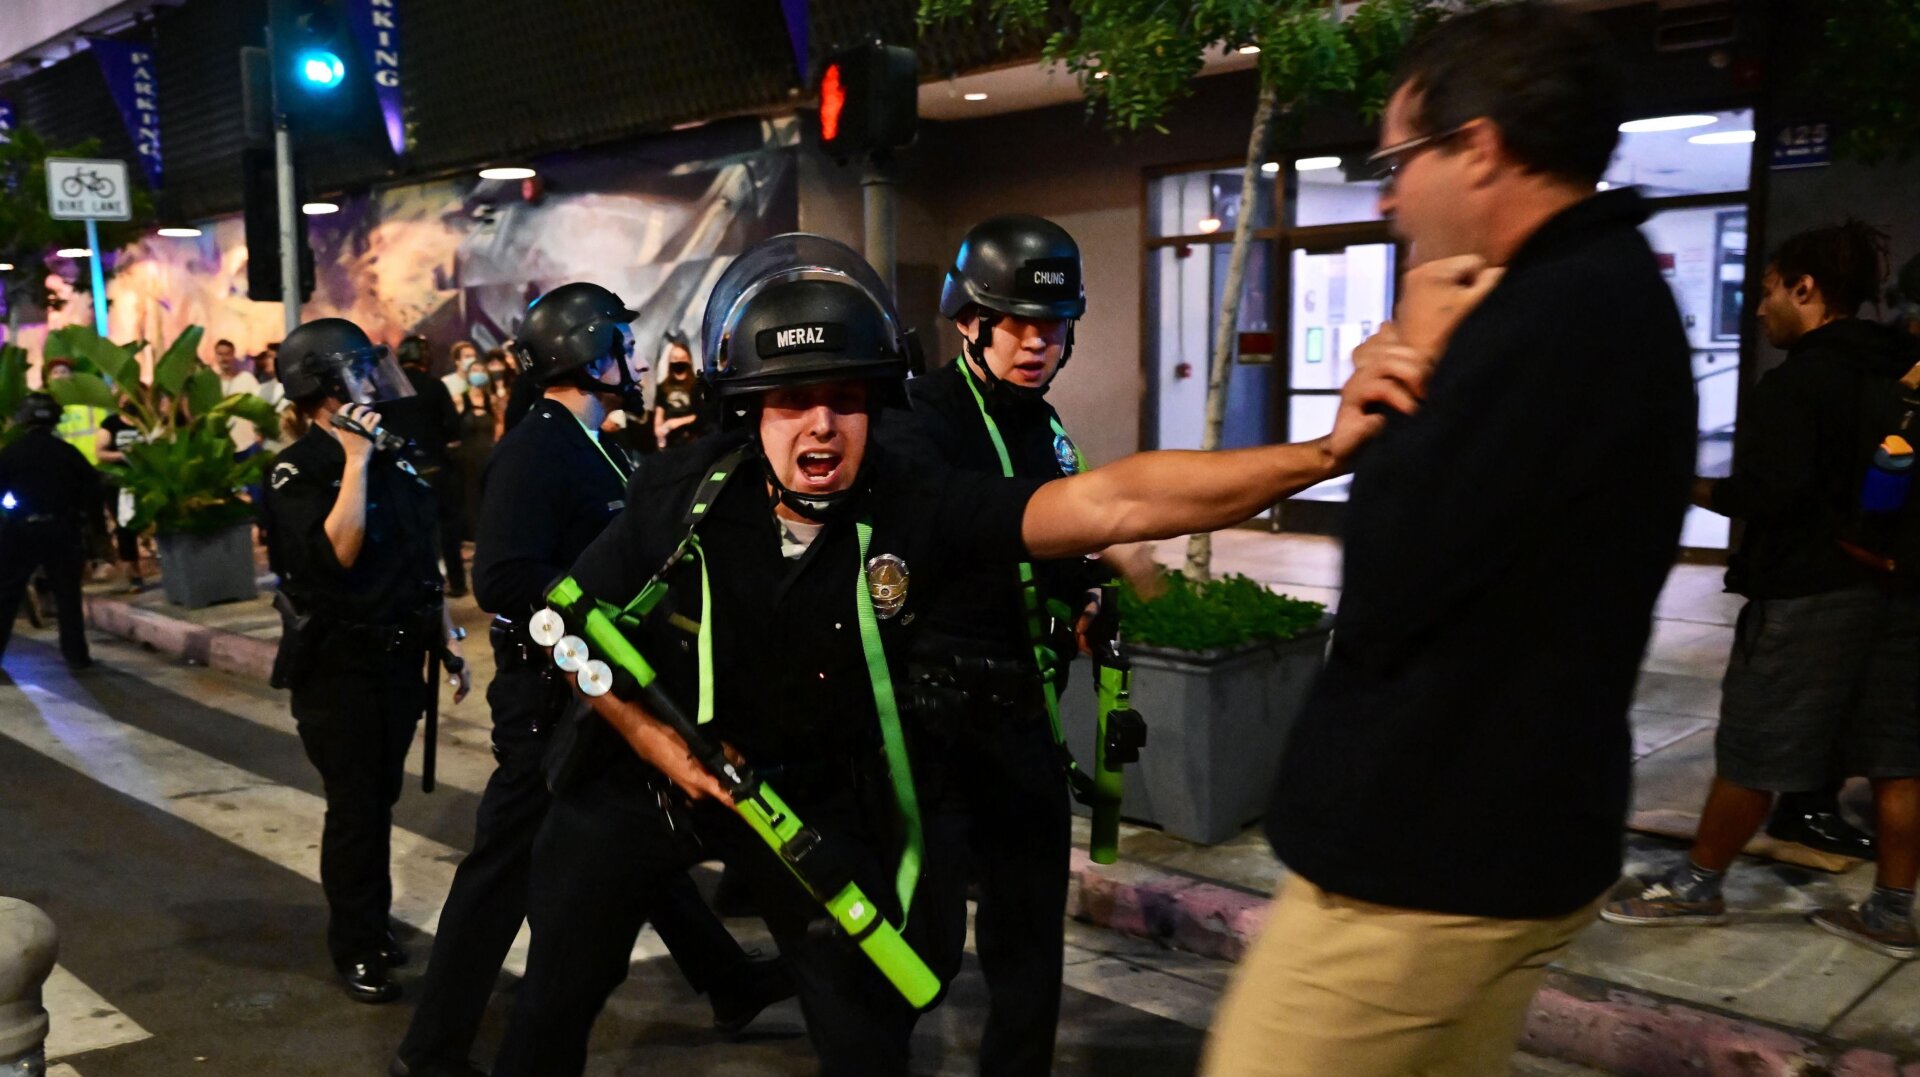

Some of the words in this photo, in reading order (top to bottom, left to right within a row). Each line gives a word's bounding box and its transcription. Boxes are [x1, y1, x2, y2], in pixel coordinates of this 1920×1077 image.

[131, 52, 160, 157] PARKING
[58, 200, 85, 213] BIKE
[92, 201, 122, 214] LANE
[1034, 270, 1065, 285] CHUNG
[776, 327, 825, 348] MERAZ
